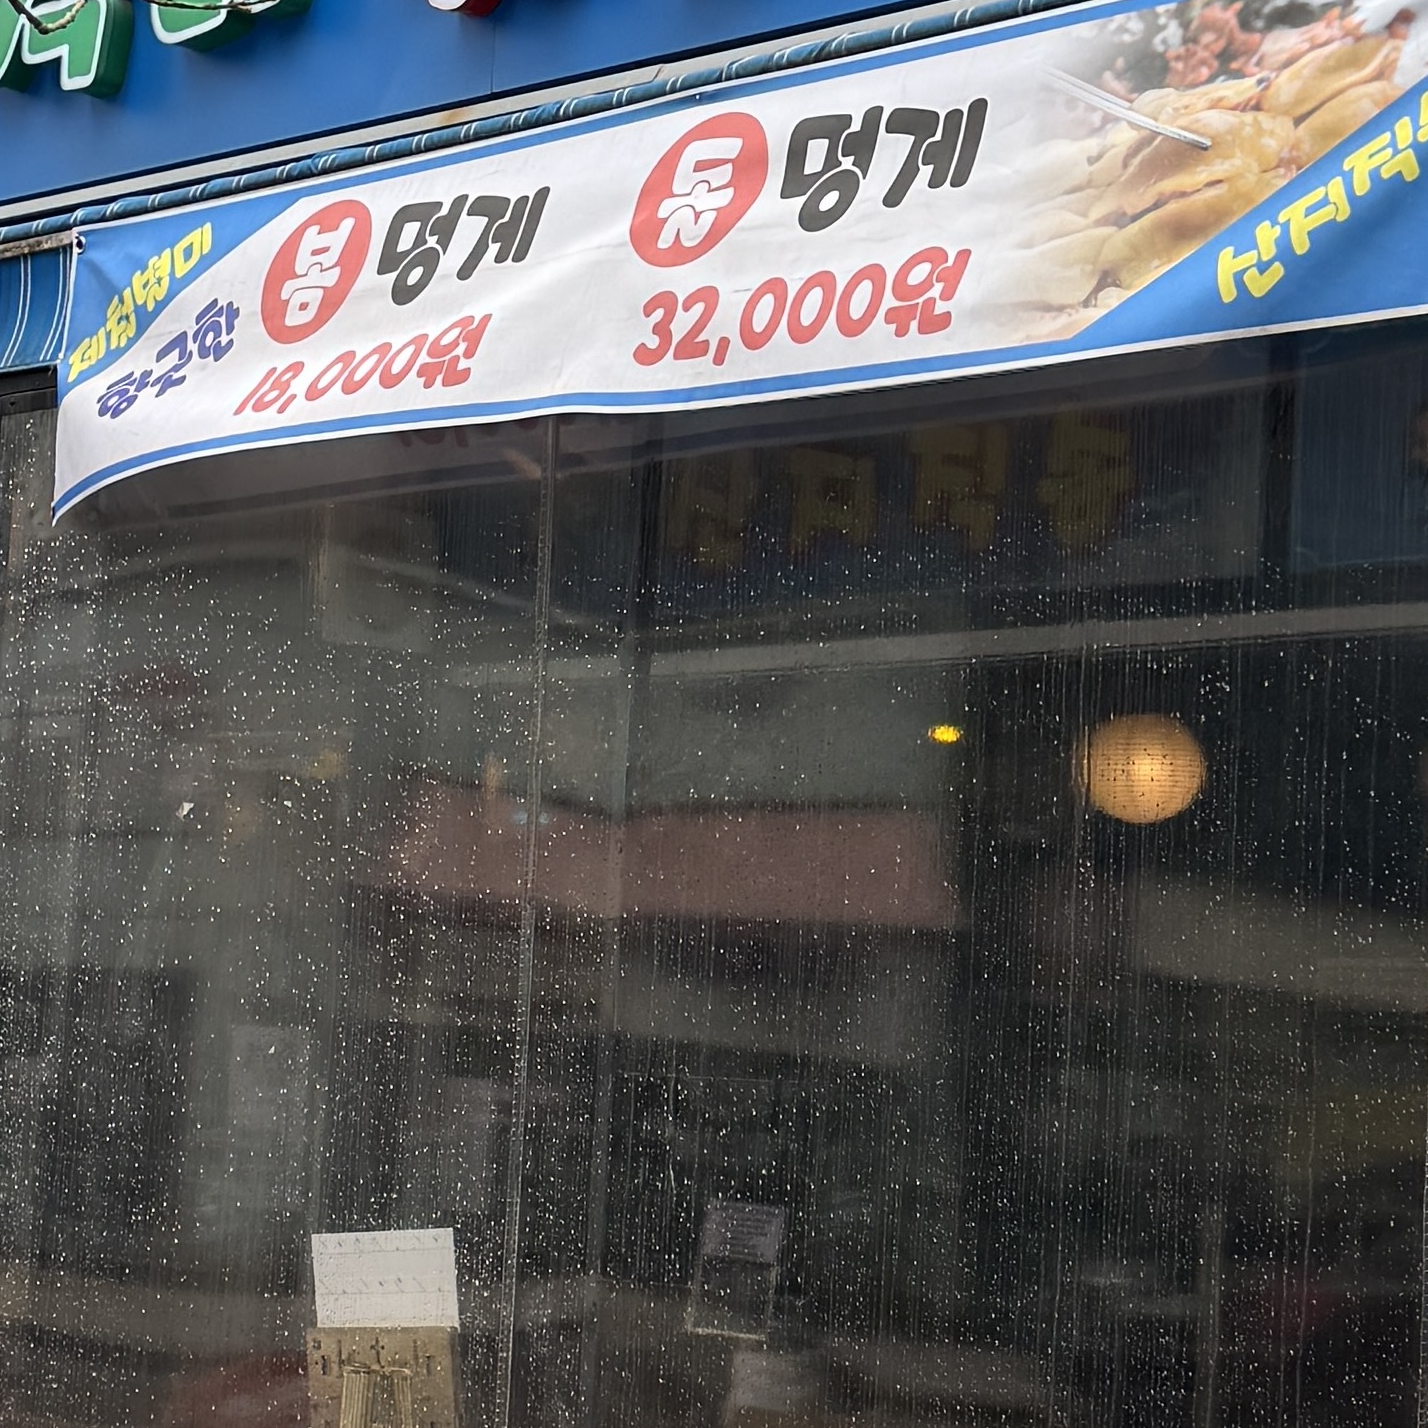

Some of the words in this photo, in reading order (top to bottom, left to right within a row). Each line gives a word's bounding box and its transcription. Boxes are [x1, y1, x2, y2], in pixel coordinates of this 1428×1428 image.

[657, 137, 744, 250] 돌
[780, 97, 989, 233] 멍게
[67, 222, 213, 384] 제철별미
[279, 213, 357, 326] 봄
[376, 186, 551, 306] 멍게
[633, 245, 972, 368] 32,000원
[96, 297, 241, 420] 향긋한
[233, 313, 493, 417] 18,000원
